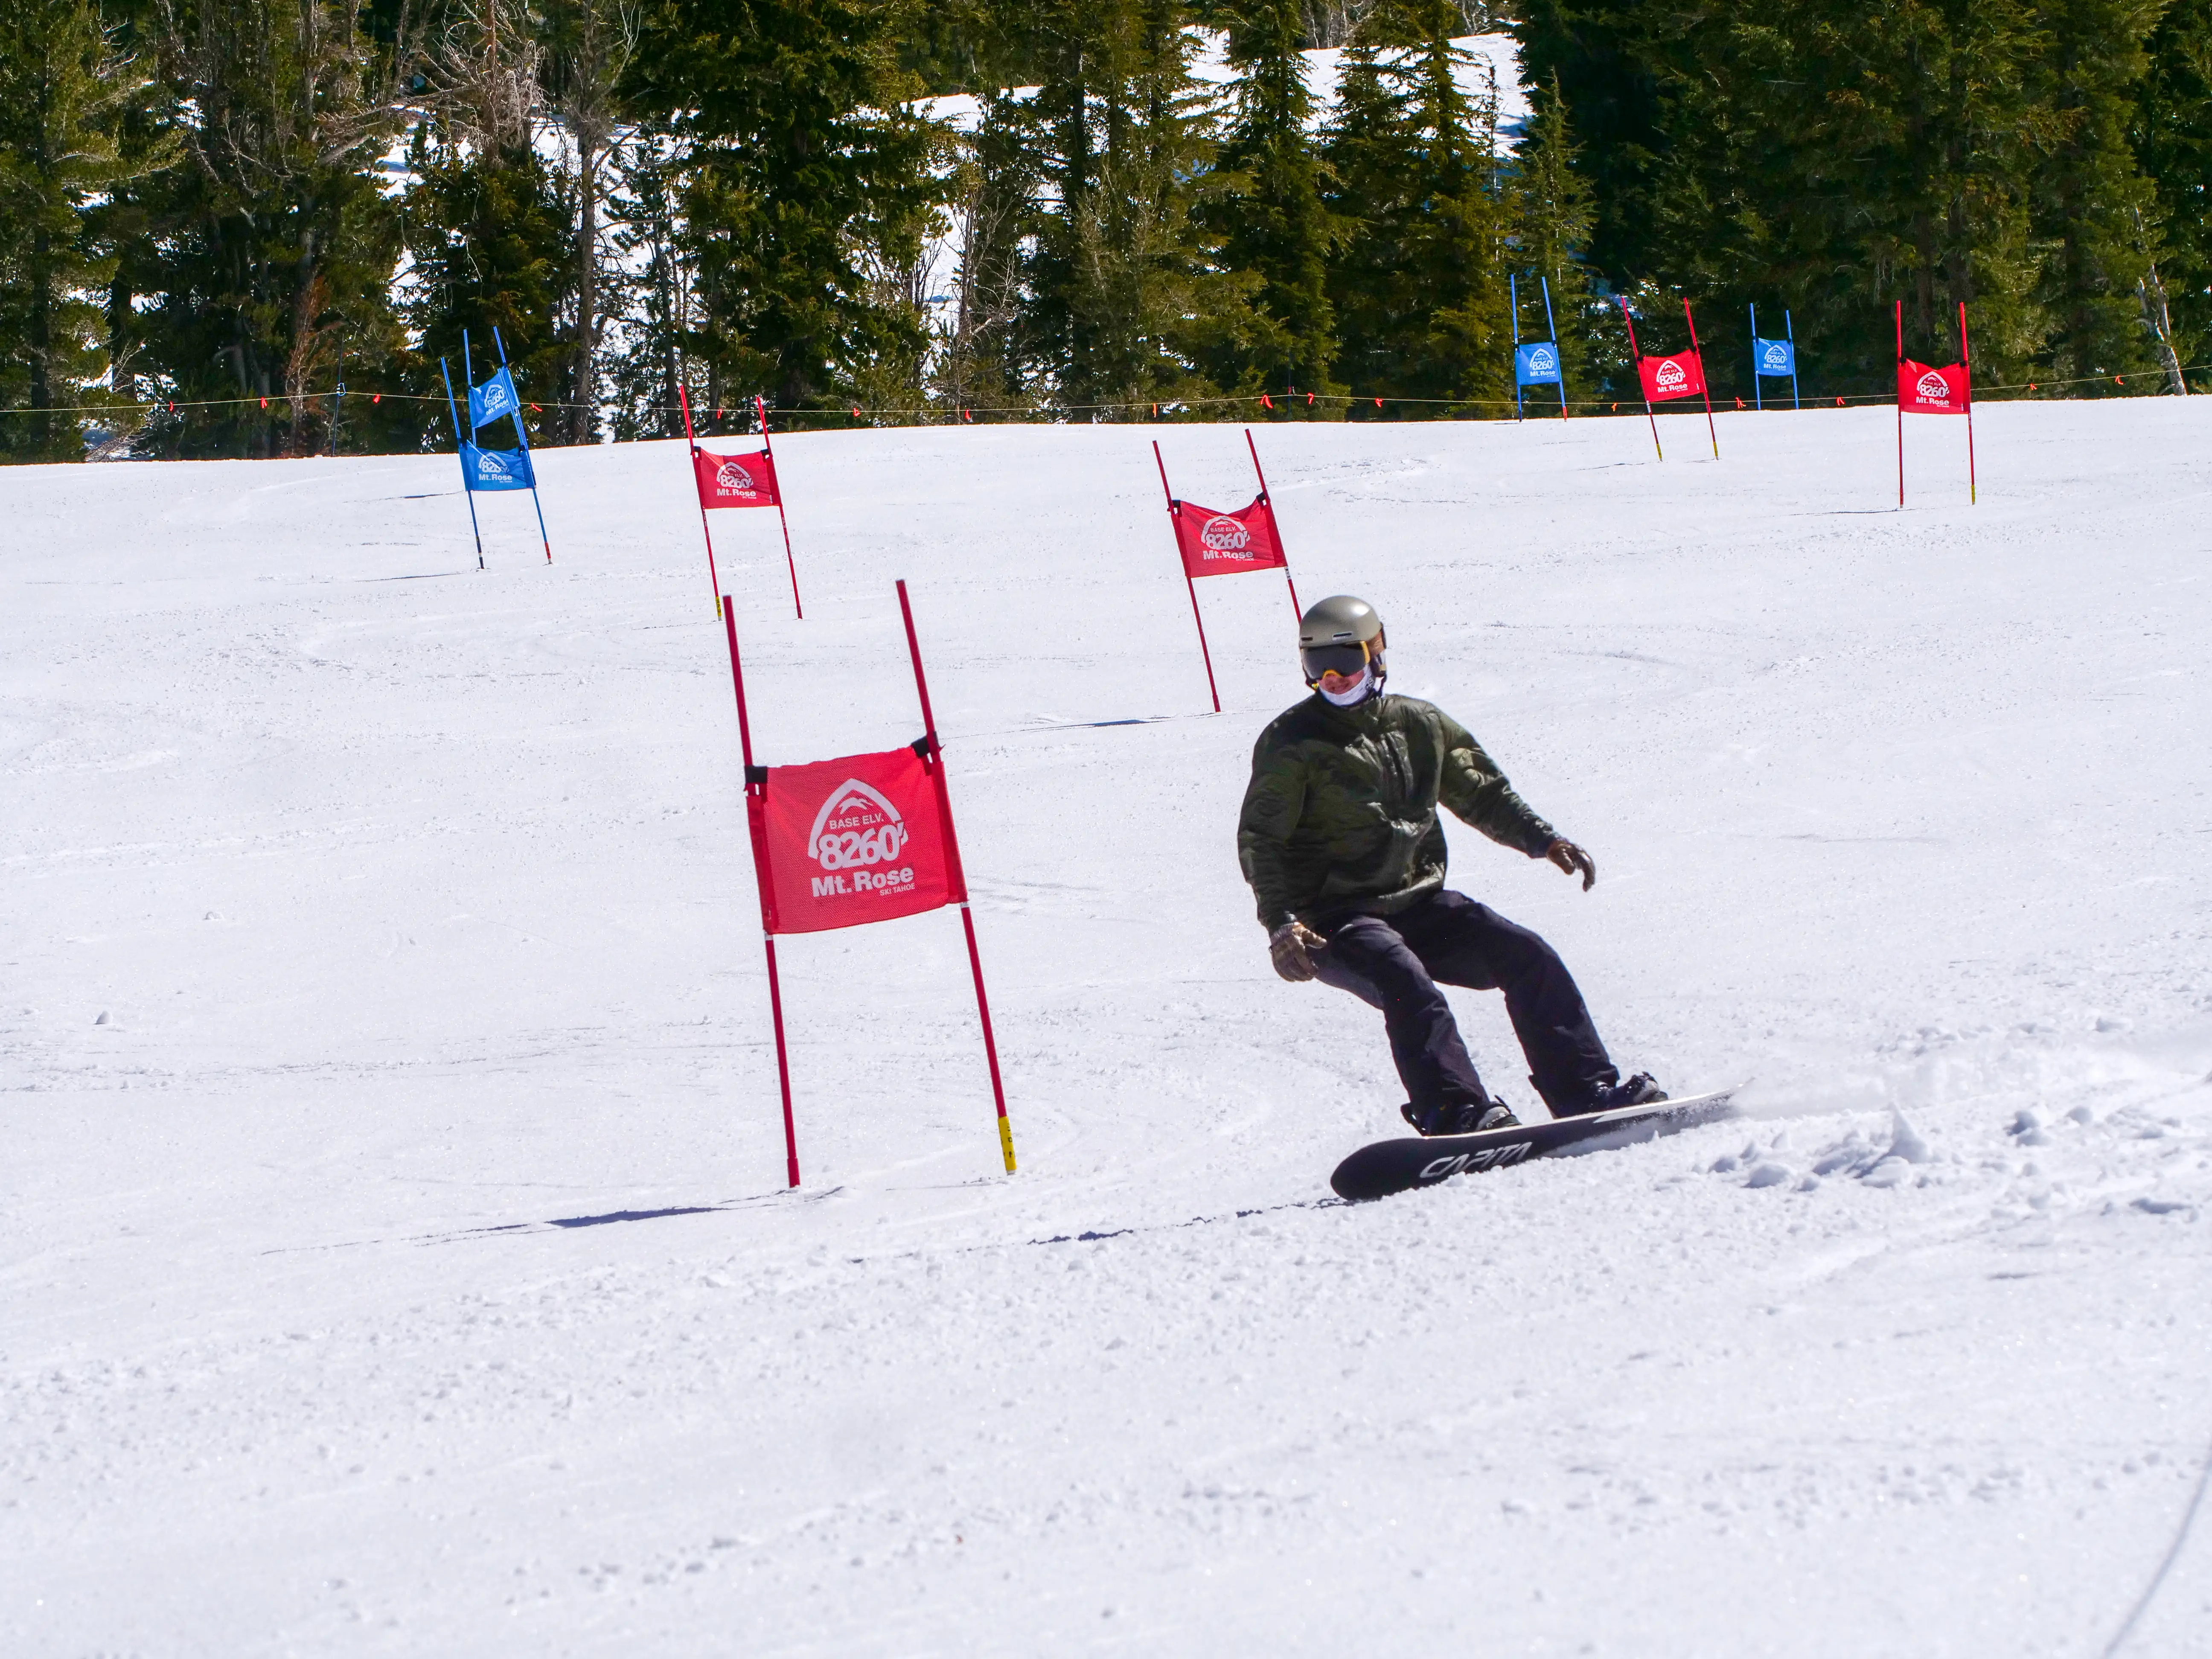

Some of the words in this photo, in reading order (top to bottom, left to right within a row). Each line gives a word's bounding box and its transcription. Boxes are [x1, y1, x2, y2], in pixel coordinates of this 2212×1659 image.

[717, 488, 732, 496] Mt.
[732, 489, 756, 497] Rose
[1206, 530, 1248, 550] 8260'
[1203, 550, 1222, 560] Mt.
[1222, 551, 1254, 559] Rose
[829, 818, 860, 830] BASE
[862, 812, 885, 824] ELV.
[818, 822, 904, 871] 8260'
[811, 875, 853, 897] Mt.
[854, 867, 914, 892] Rose
[879, 888, 892, 896] SKI
[892, 882, 916, 894] TAHOE
